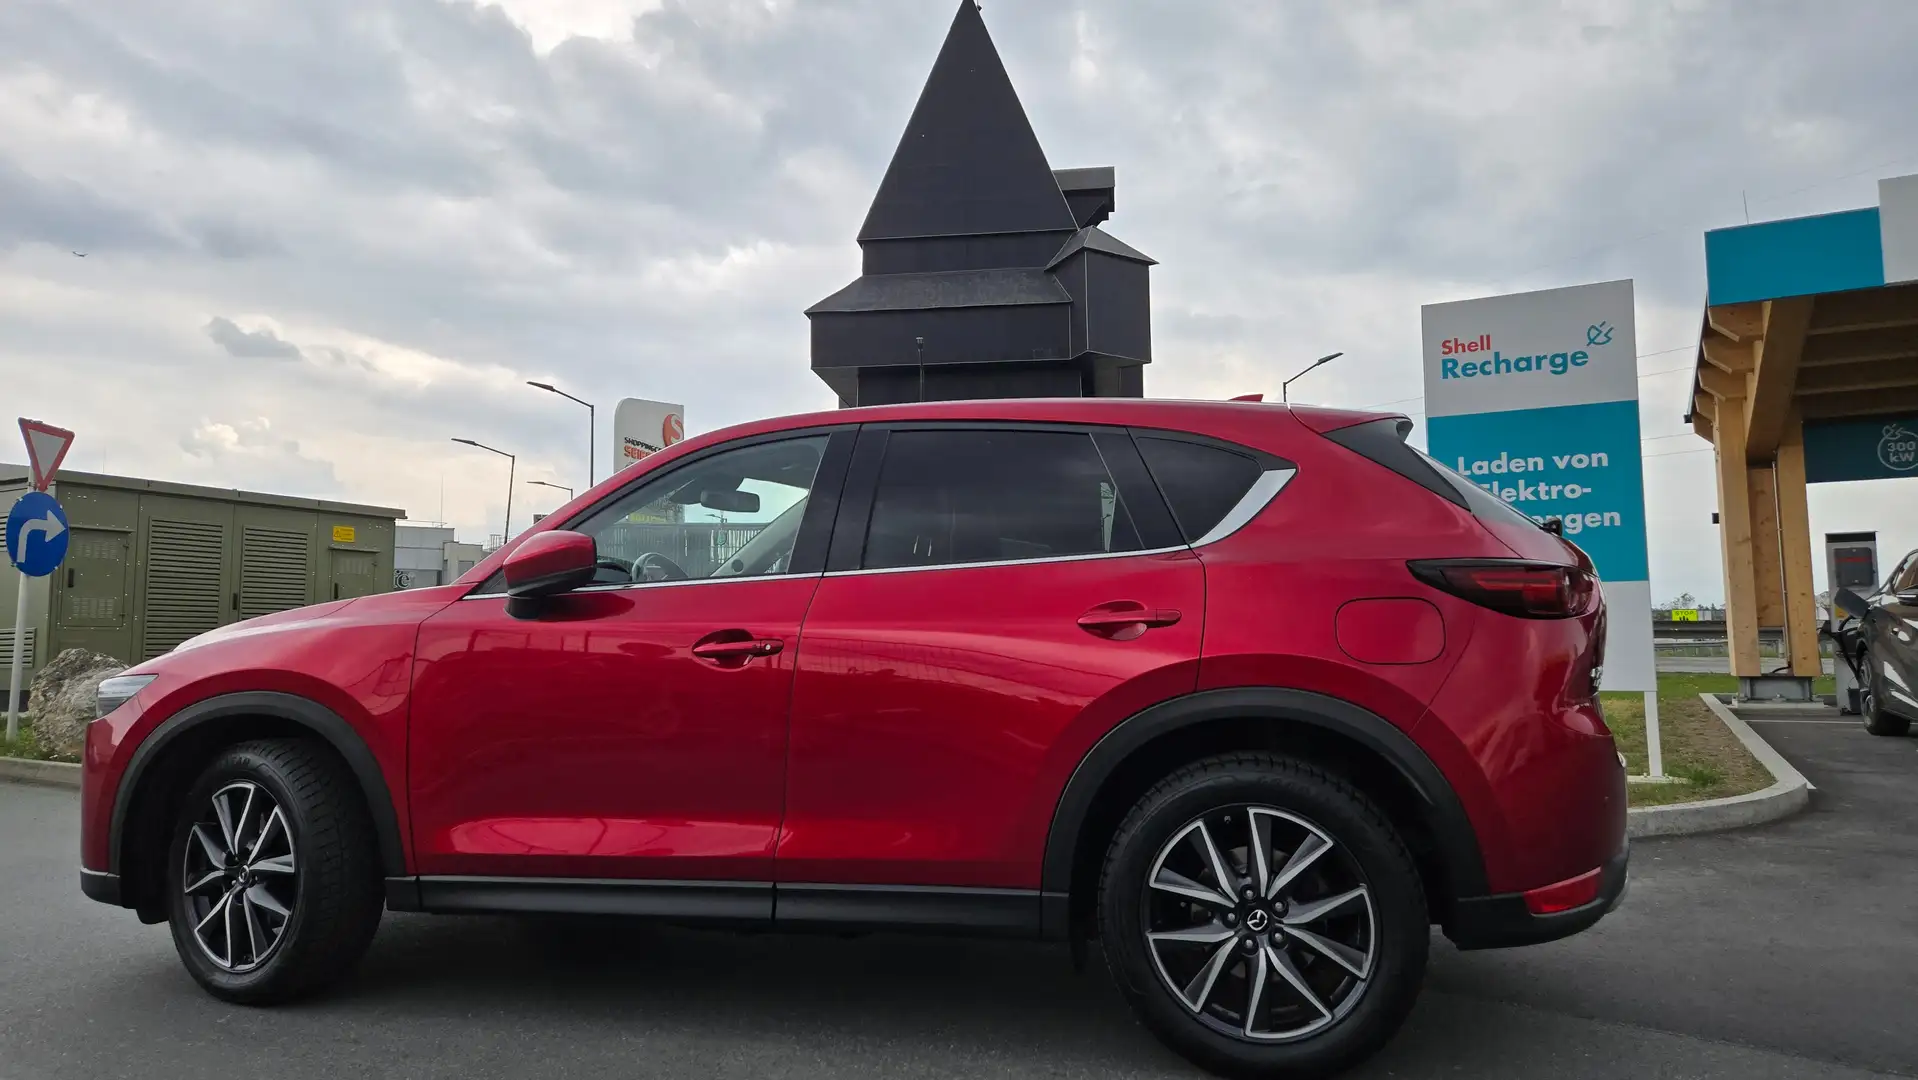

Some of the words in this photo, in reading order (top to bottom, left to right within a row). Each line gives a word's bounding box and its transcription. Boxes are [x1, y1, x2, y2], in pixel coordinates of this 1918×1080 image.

[1442, 335, 1491, 355] Shell
[1442, 351, 1589, 379] Recharge
[1888, 441, 1916, 451] 300
[1458, 452, 1544, 476] Laden
[1552, 452, 1608, 469] von
[1890, 452, 1914, 462] kW
